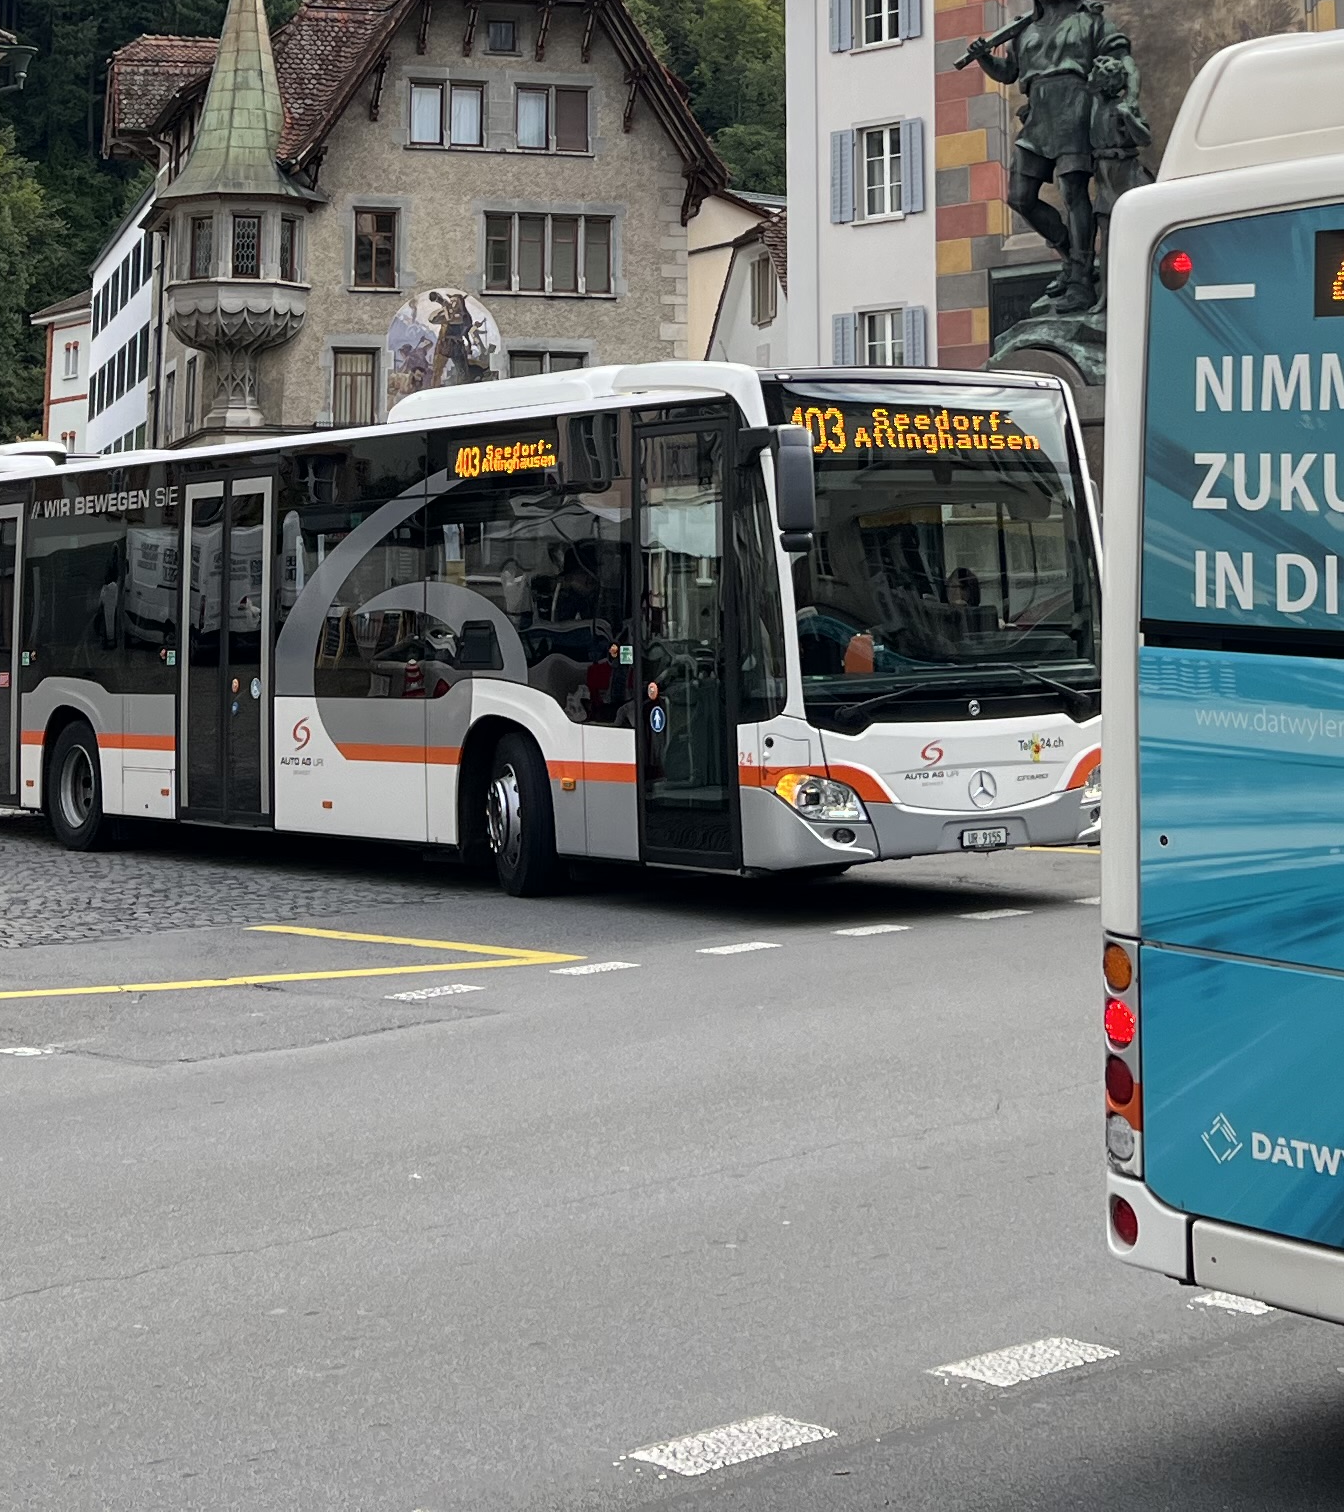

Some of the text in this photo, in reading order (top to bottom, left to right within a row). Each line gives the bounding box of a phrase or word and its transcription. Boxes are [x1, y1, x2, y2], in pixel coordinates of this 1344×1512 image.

[454, 445, 481, 478] 403
[43, 498, 71, 519] WIR
[73, 489, 151, 516] BEWEGEN
[154, 485, 179, 508] SIE
[1193, 549, 1255, 611] IN
